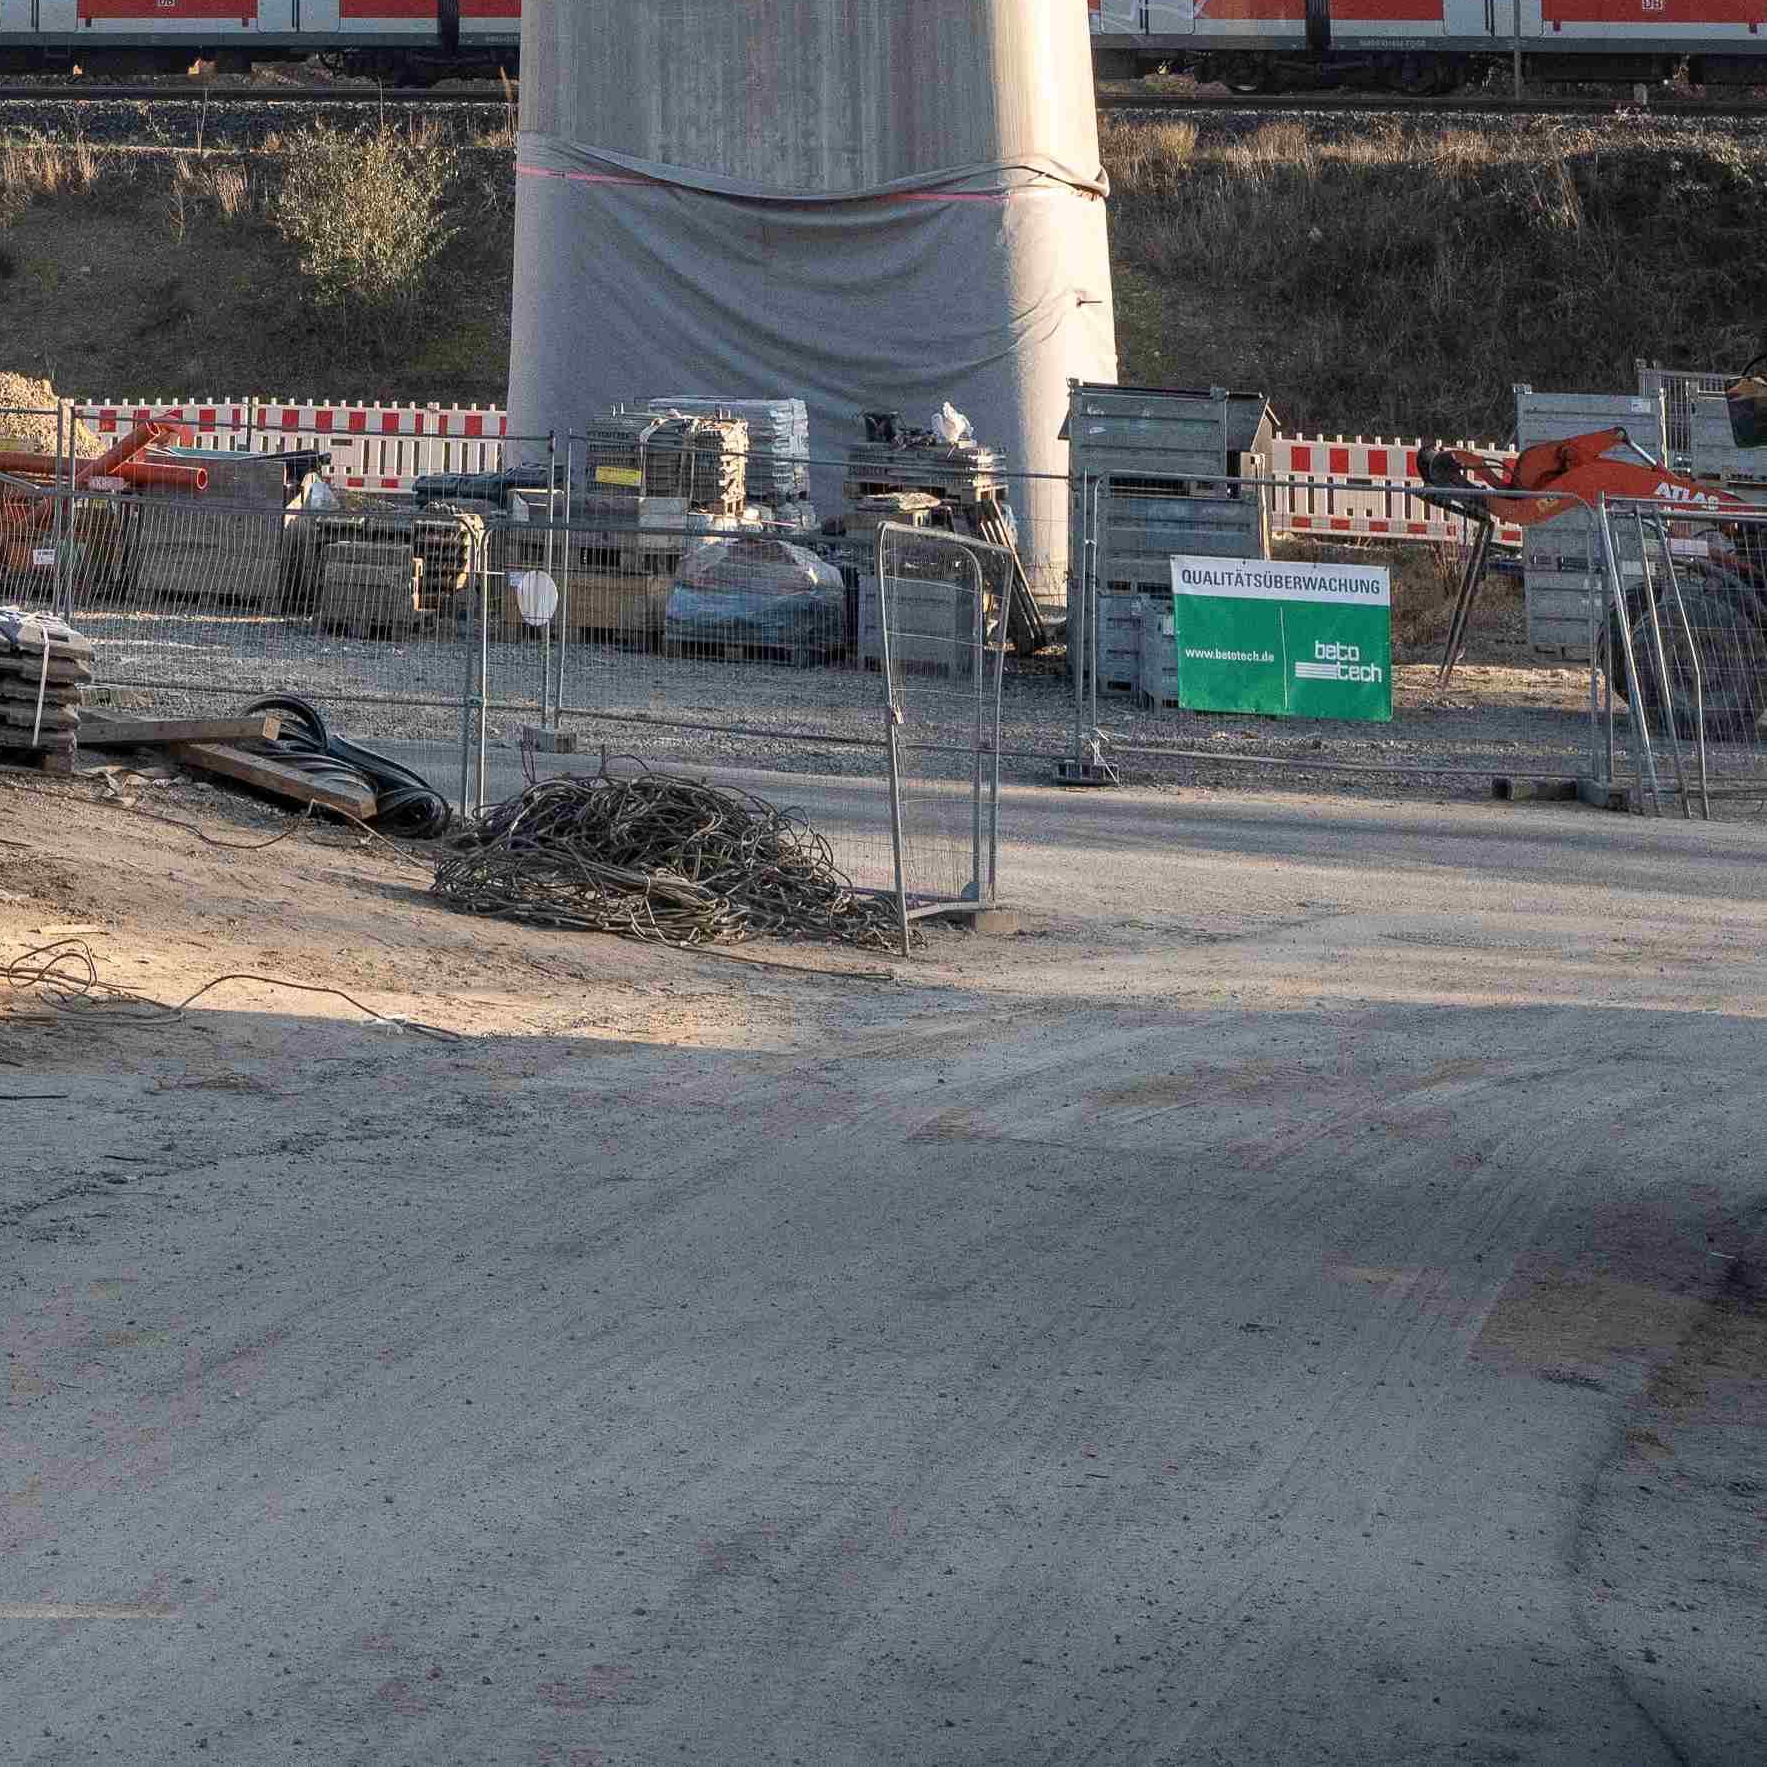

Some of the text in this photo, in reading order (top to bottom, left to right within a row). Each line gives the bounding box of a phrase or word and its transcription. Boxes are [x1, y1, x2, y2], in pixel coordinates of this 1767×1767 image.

[1182, 569, 1380, 595] QUALITÄTSÜBERWACHUNG
[1185, 647, 1274, 663] www.betotech.de
[1314, 640, 1359, 662] beto
[1337, 661, 1382, 683] tech
